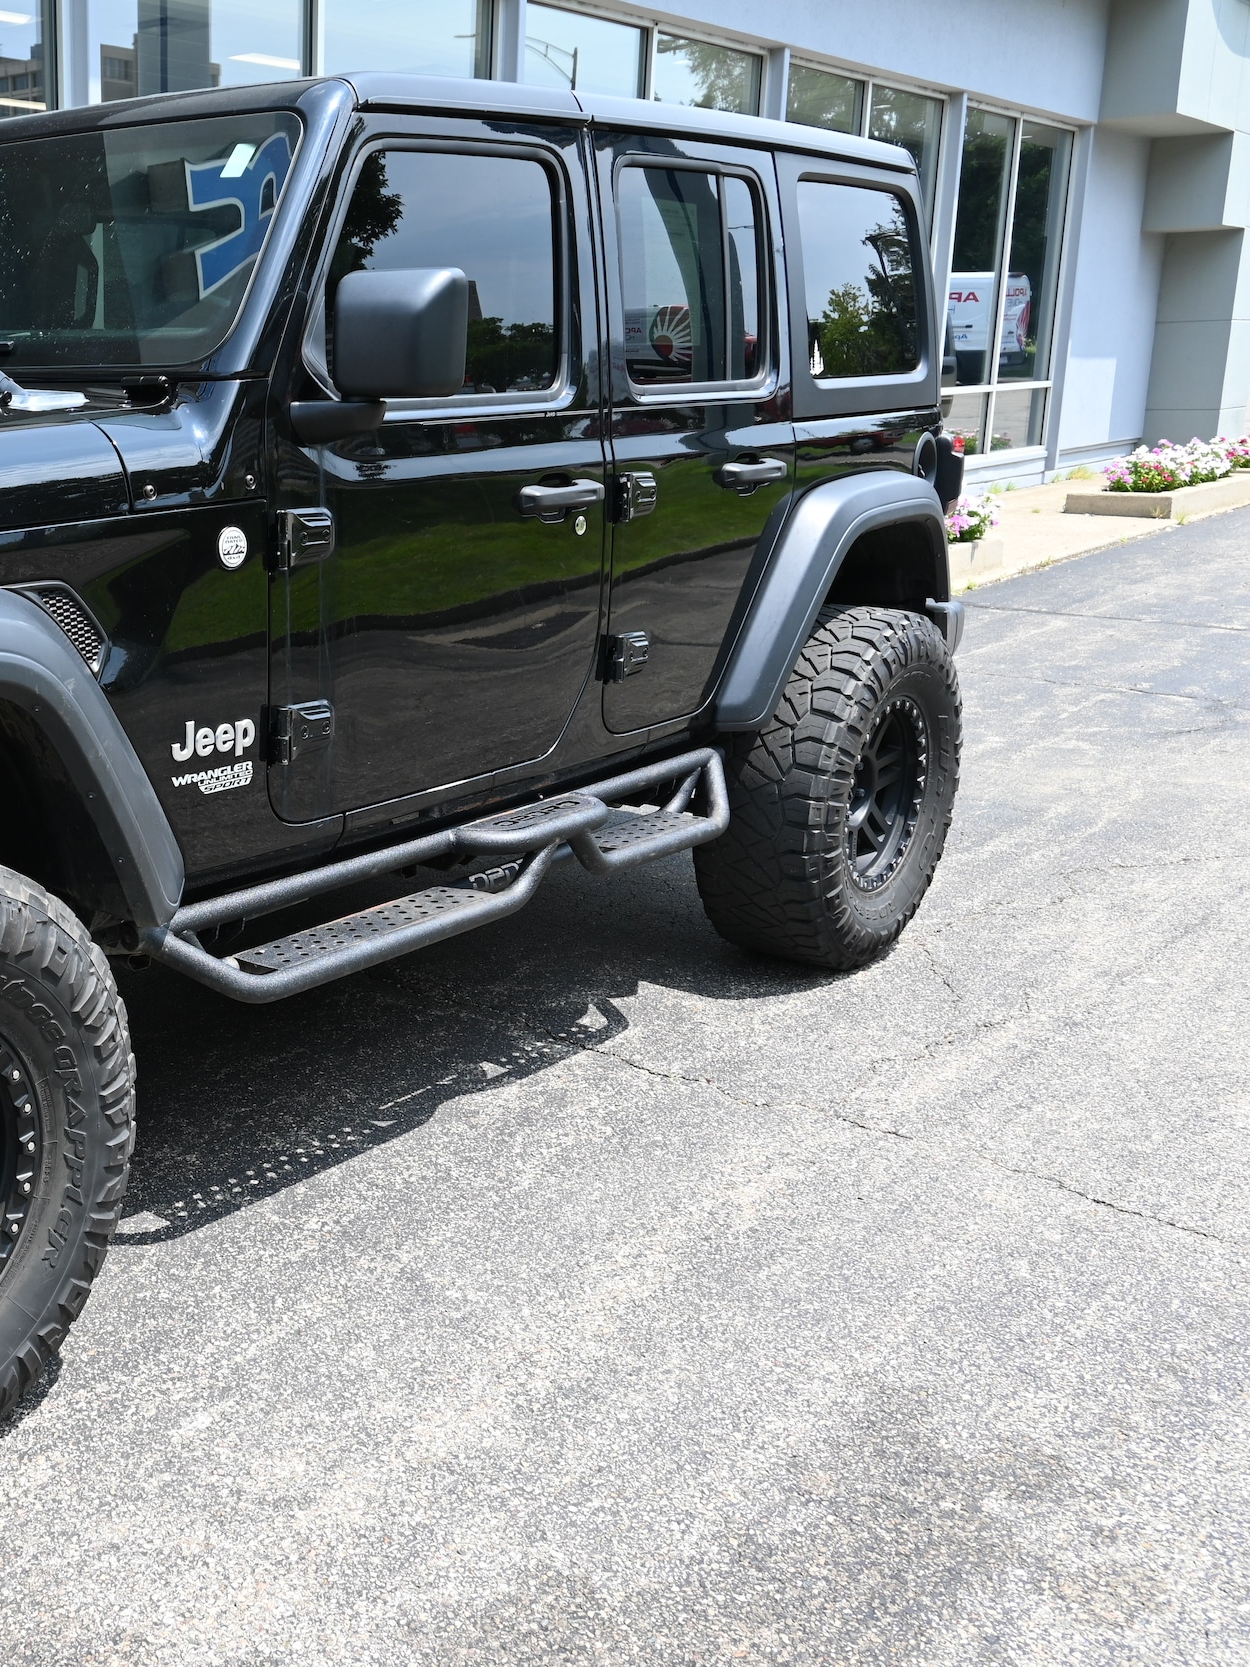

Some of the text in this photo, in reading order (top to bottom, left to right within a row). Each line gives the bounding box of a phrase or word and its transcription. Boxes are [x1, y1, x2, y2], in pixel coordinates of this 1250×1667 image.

[171, 718, 255, 762] Jeep
[171, 760, 253, 787] WRANGLER
[197, 769, 253, 786] UNLIMITED
